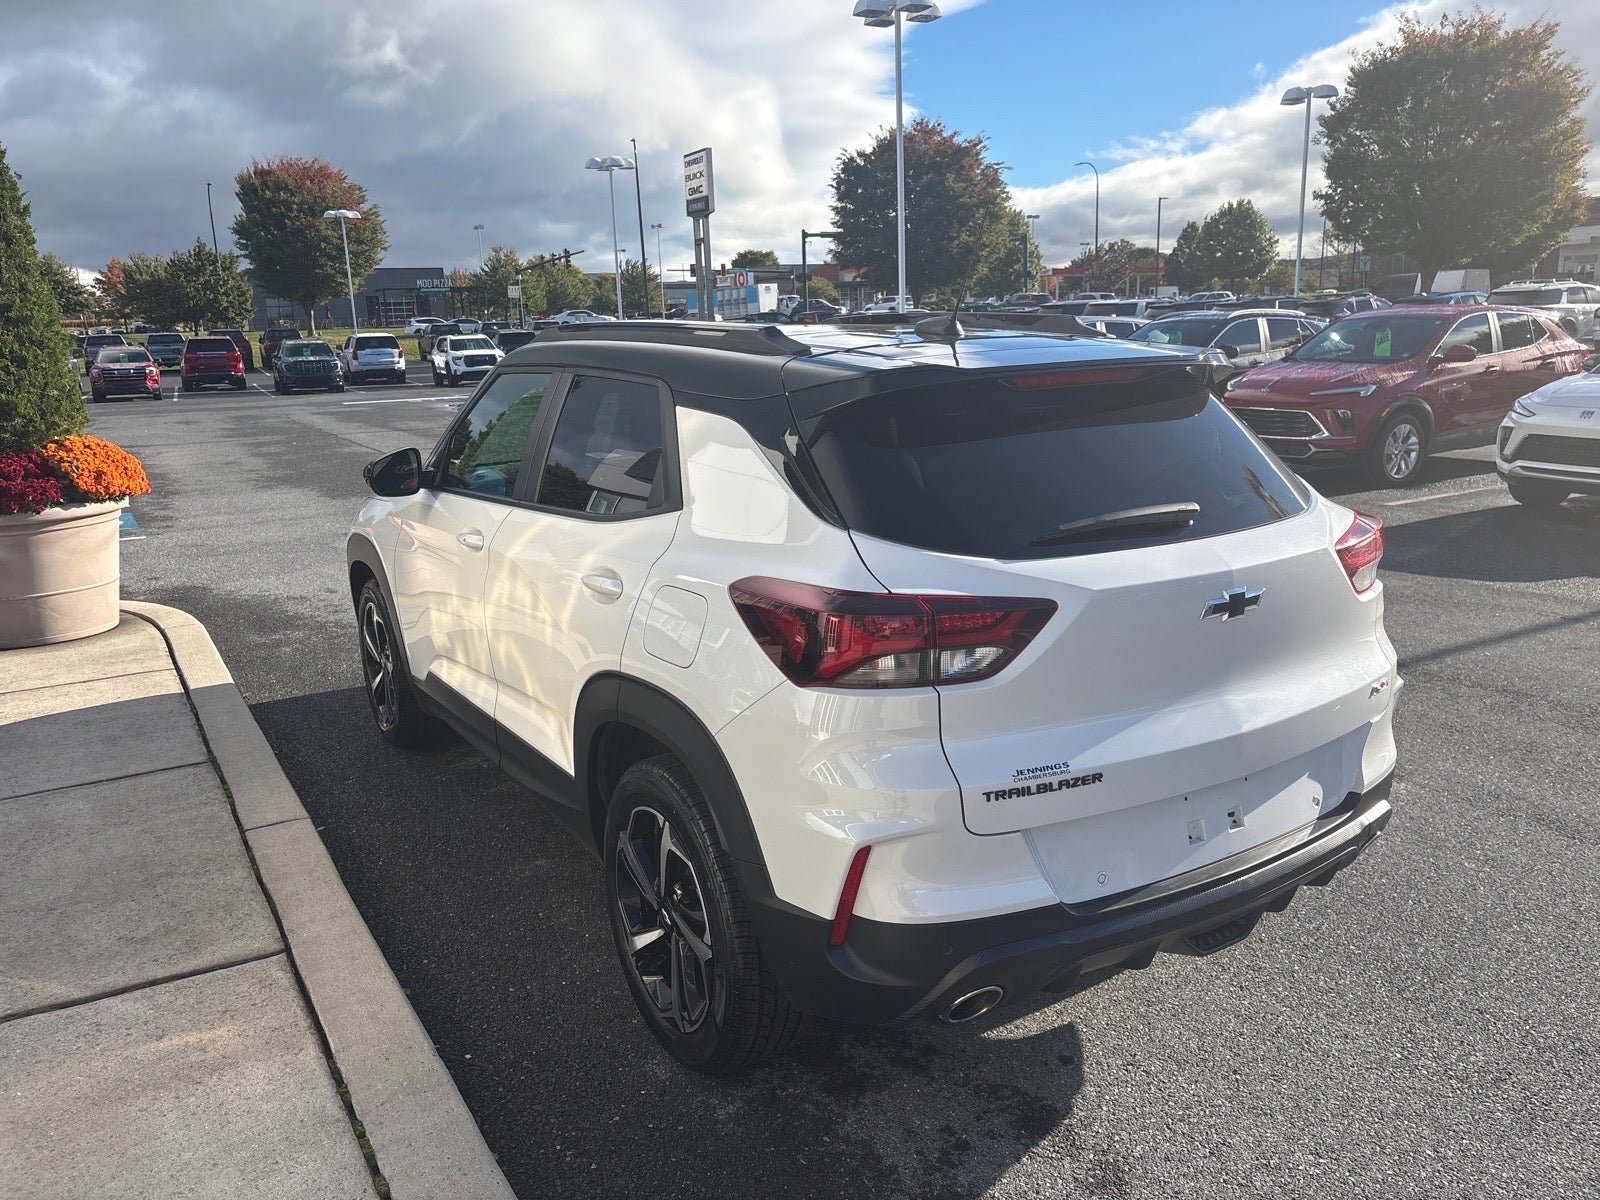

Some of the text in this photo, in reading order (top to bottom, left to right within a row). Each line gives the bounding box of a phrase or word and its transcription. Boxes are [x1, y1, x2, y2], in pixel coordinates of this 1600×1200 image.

[685, 156, 704, 168] CHEVROLET
[685, 170, 704, 182] BUICK
[688, 185, 704, 196] GMC
[433, 278, 453, 288] PIZZA
[1012, 762, 1070, 777] JENNINGS
[1013, 769, 1071, 783] CHAMBERSBURG
[982, 772, 1103, 802] TRAILBLAZER
